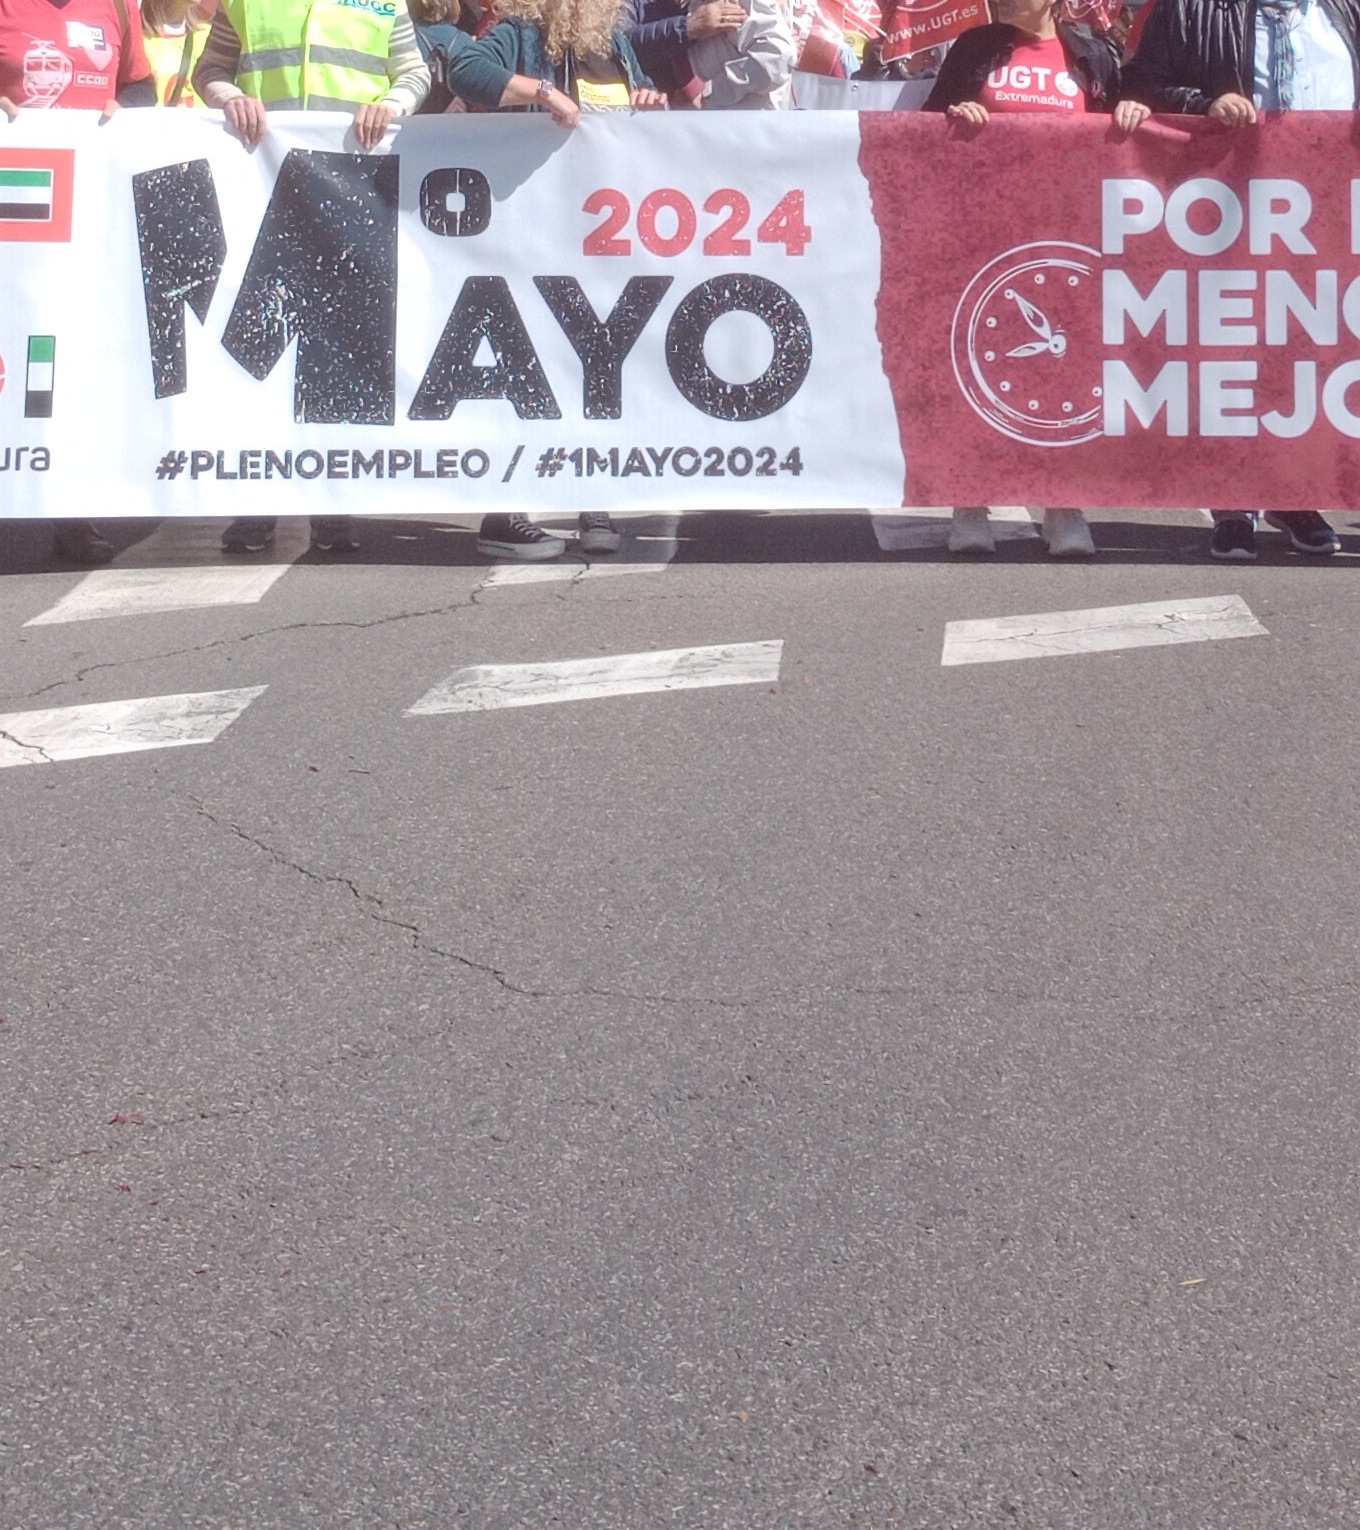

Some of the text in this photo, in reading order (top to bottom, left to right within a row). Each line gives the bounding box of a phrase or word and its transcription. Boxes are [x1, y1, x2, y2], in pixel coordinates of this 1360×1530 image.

[987, 64, 1051, 91] UGT
[994, 90, 1074, 110] Extremadura
[581, 187, 812, 258] 2024
[1102, 177, 1317, 256] POR
[155, 447, 490, 481] #PLENOEMPLEO
[535, 445, 804, 478] #1MAYO2024
